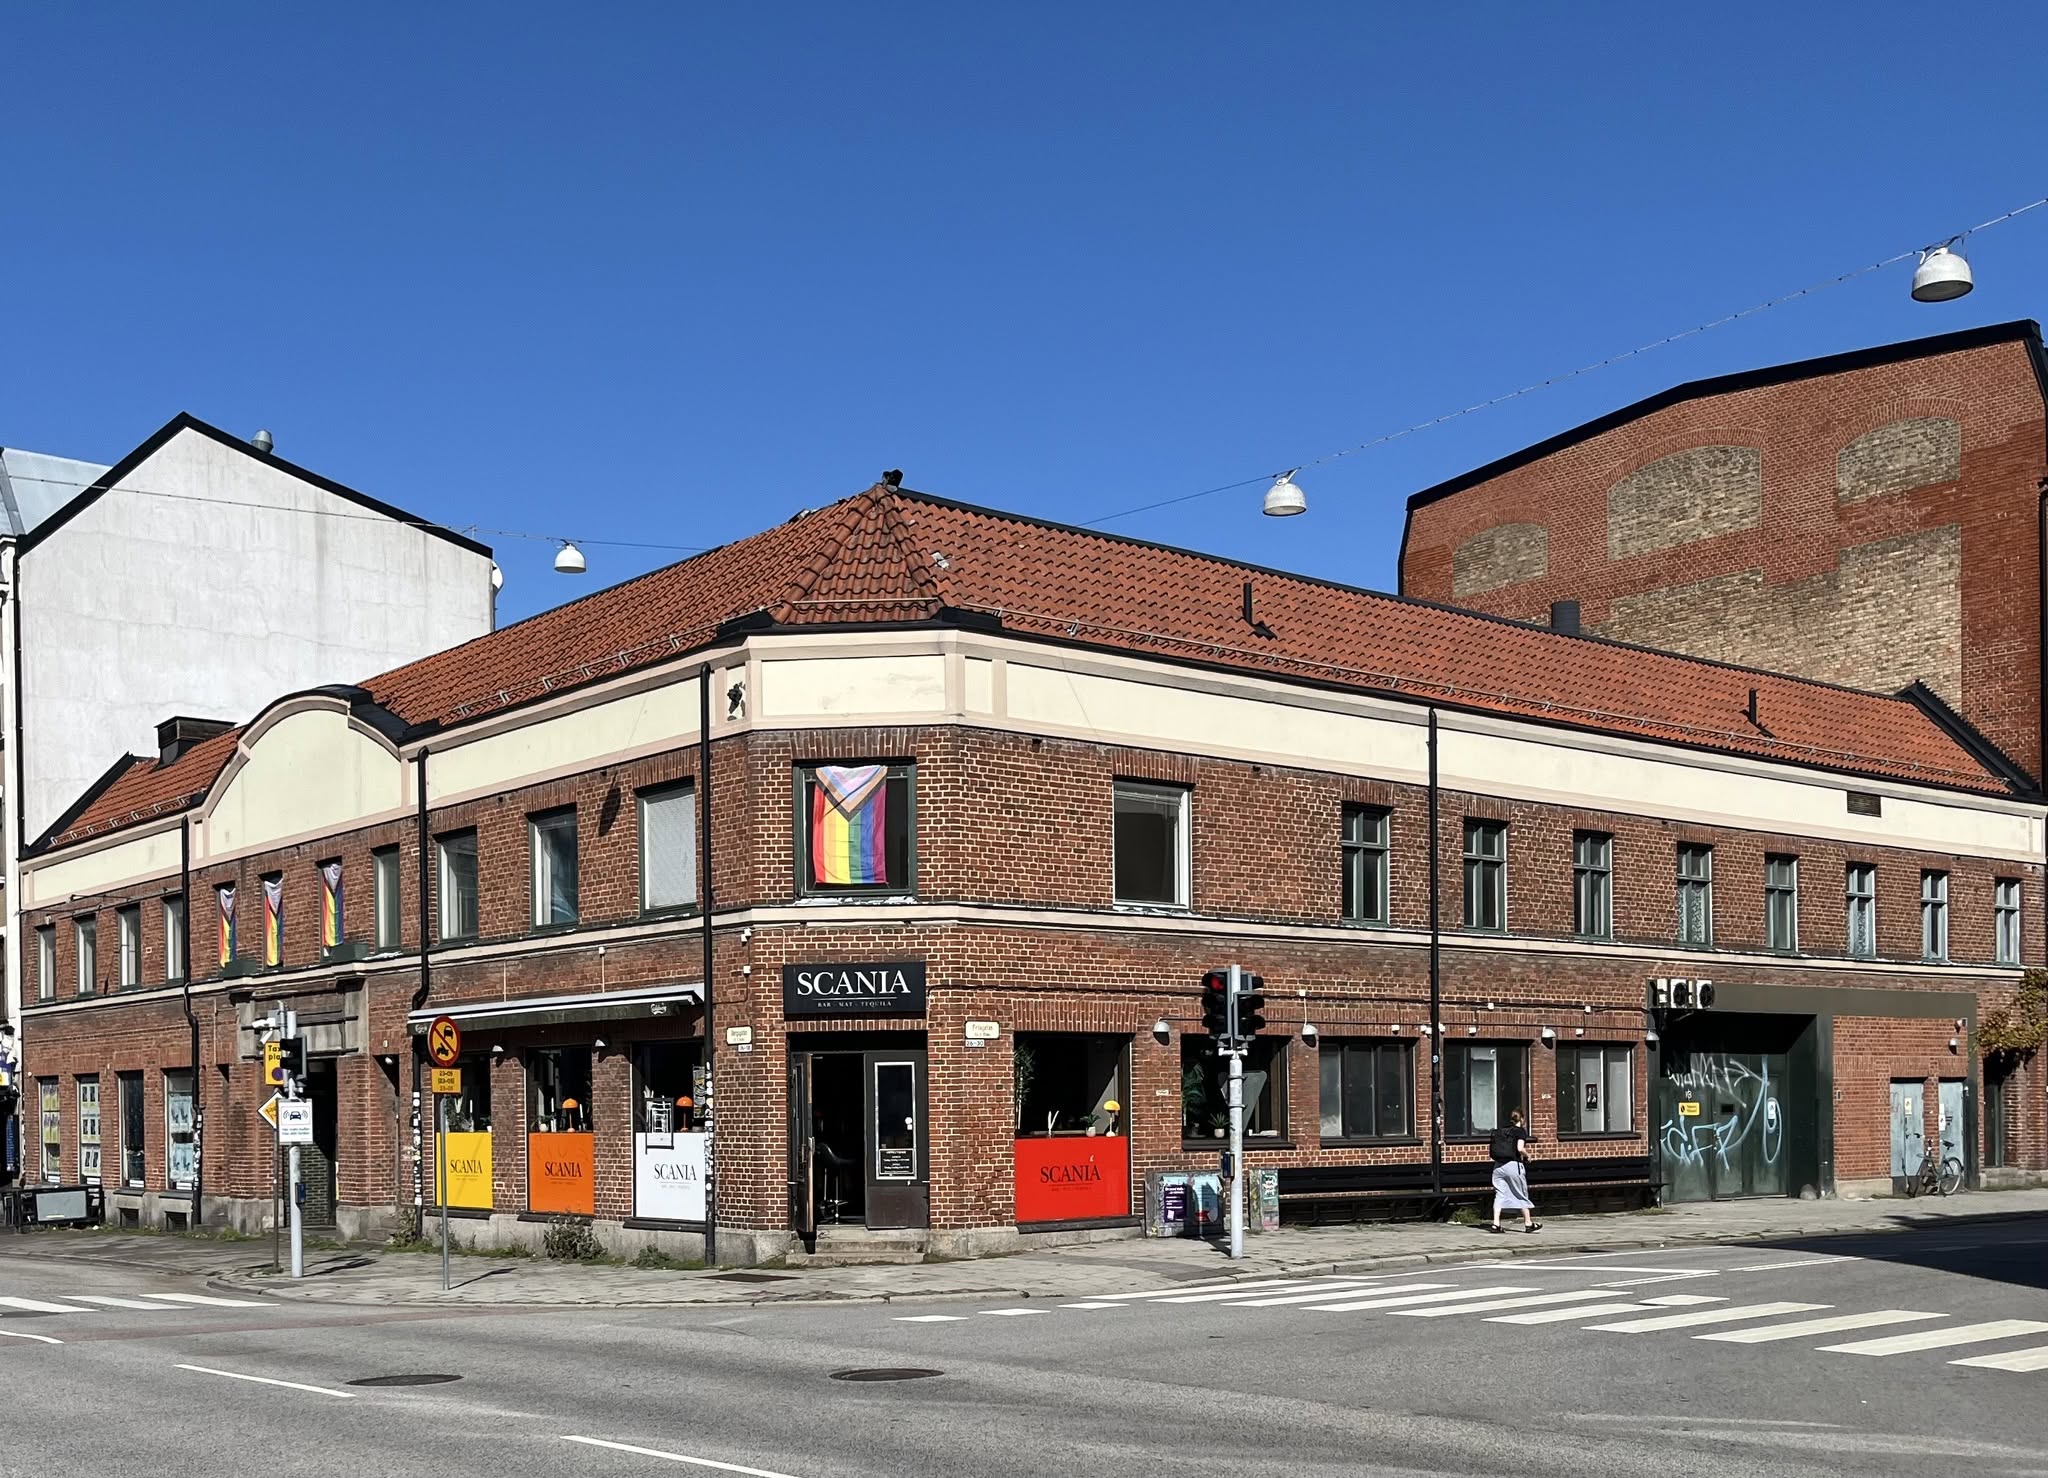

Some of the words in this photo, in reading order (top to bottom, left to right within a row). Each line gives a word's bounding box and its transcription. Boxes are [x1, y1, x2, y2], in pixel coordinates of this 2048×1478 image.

[797, 970, 911, 996] SCANIA
[450, 1159, 482, 1174] SCANIA
[544, 1161, 582, 1177] SCANIA
[654, 1163, 697, 1181] SCANIA
[1040, 1165, 1102, 1184] SCANIA
